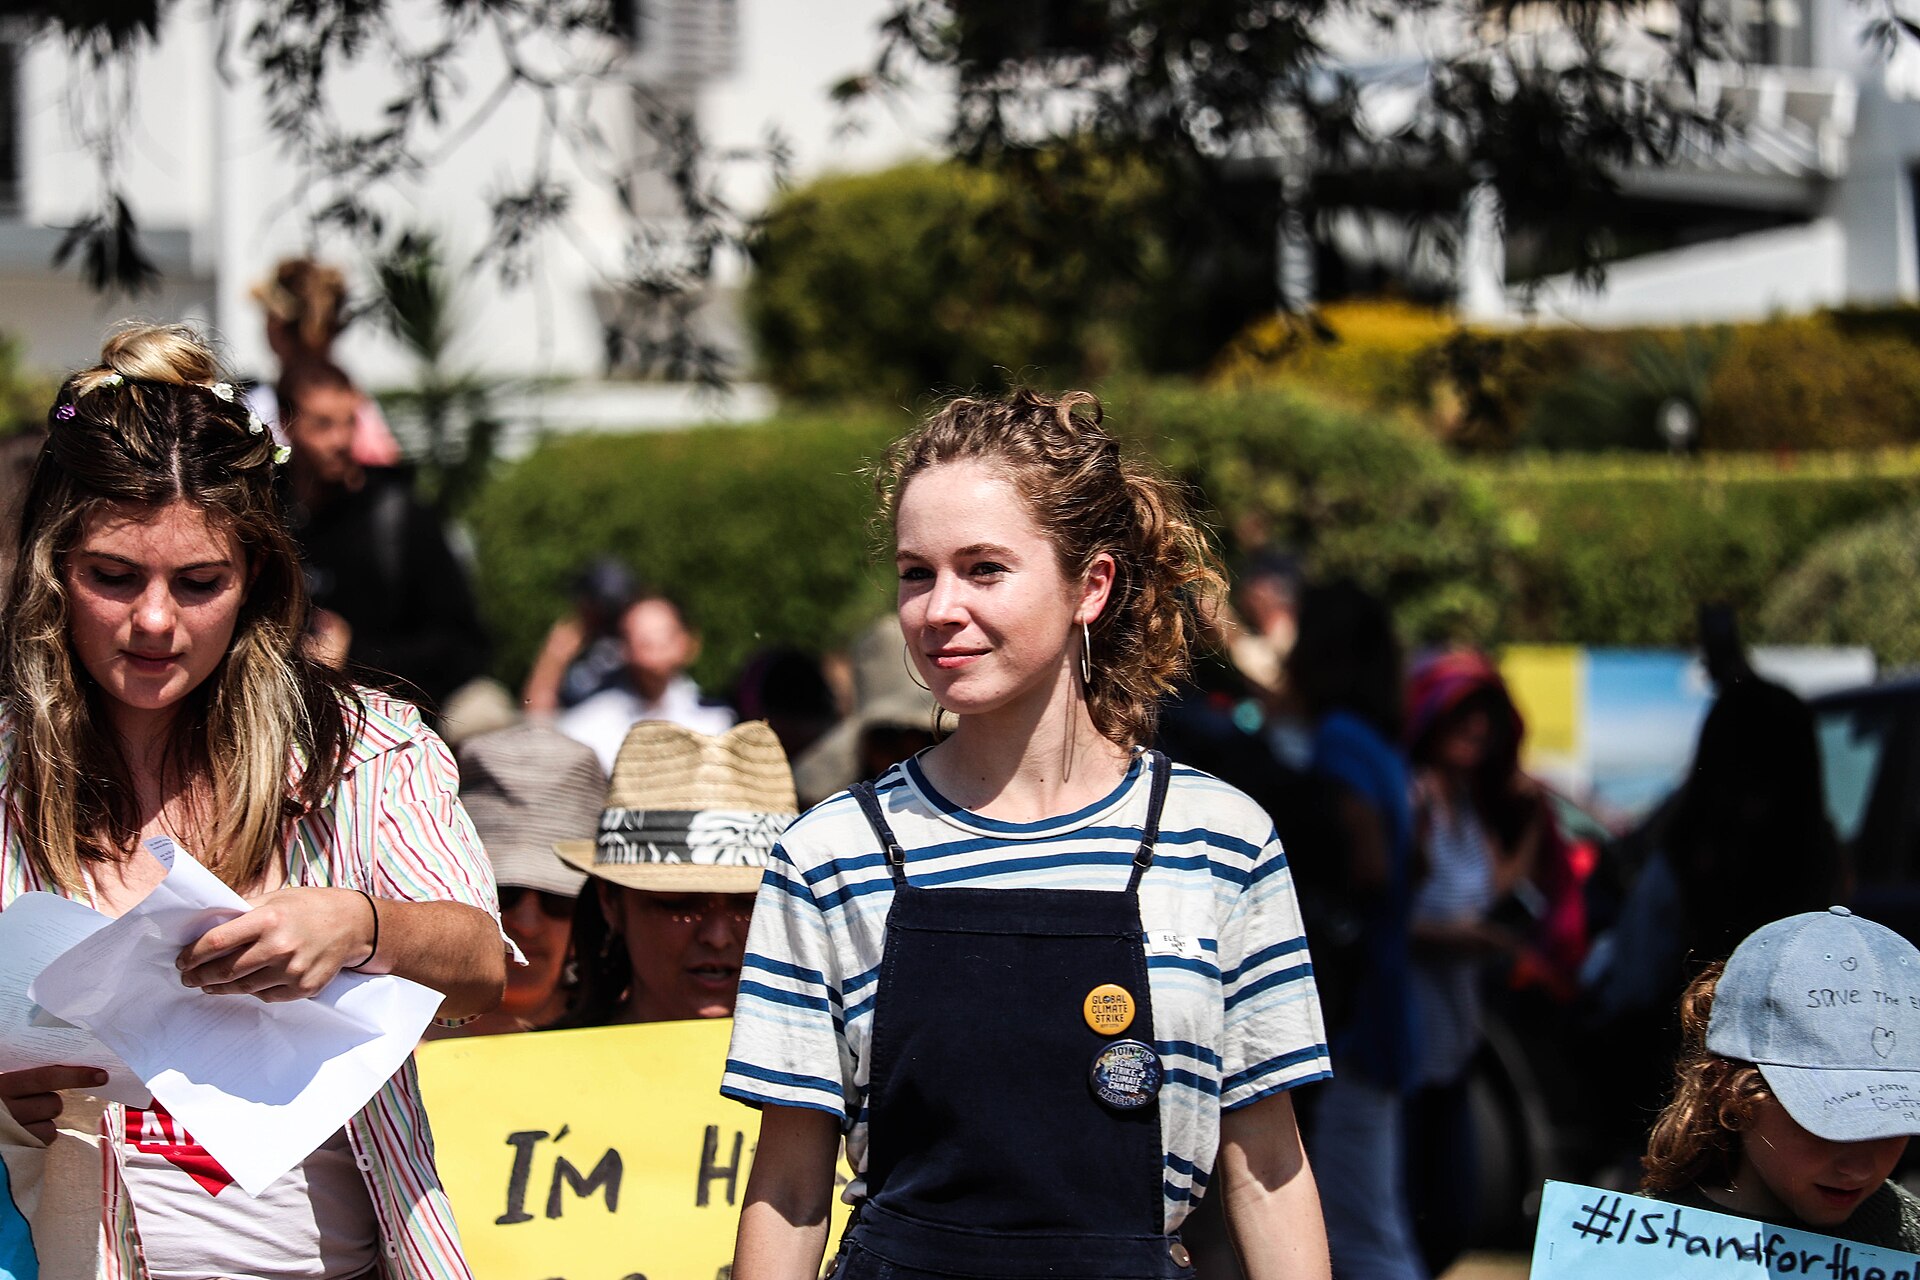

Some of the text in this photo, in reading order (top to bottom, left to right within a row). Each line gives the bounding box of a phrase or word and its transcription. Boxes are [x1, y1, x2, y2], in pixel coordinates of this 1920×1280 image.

[1092, 995, 1127, 1004] GLOBAL
[1091, 1004, 1128, 1014] CLIMATE
[1095, 1014, 1124, 1023] STRIKE
[1111, 1046, 1154, 1064] JOIN US
[1115, 1057, 1144, 1070] SCHOOL
[1110, 1065, 1146, 1079] STRIKE 4
[1109, 1073, 1143, 1086] CLIMATE
[1108, 1081, 1140, 1094] CHANGE
[1097, 1087, 1130, 1106] MARCH
[494, 1123, 624, 1226] I'M
